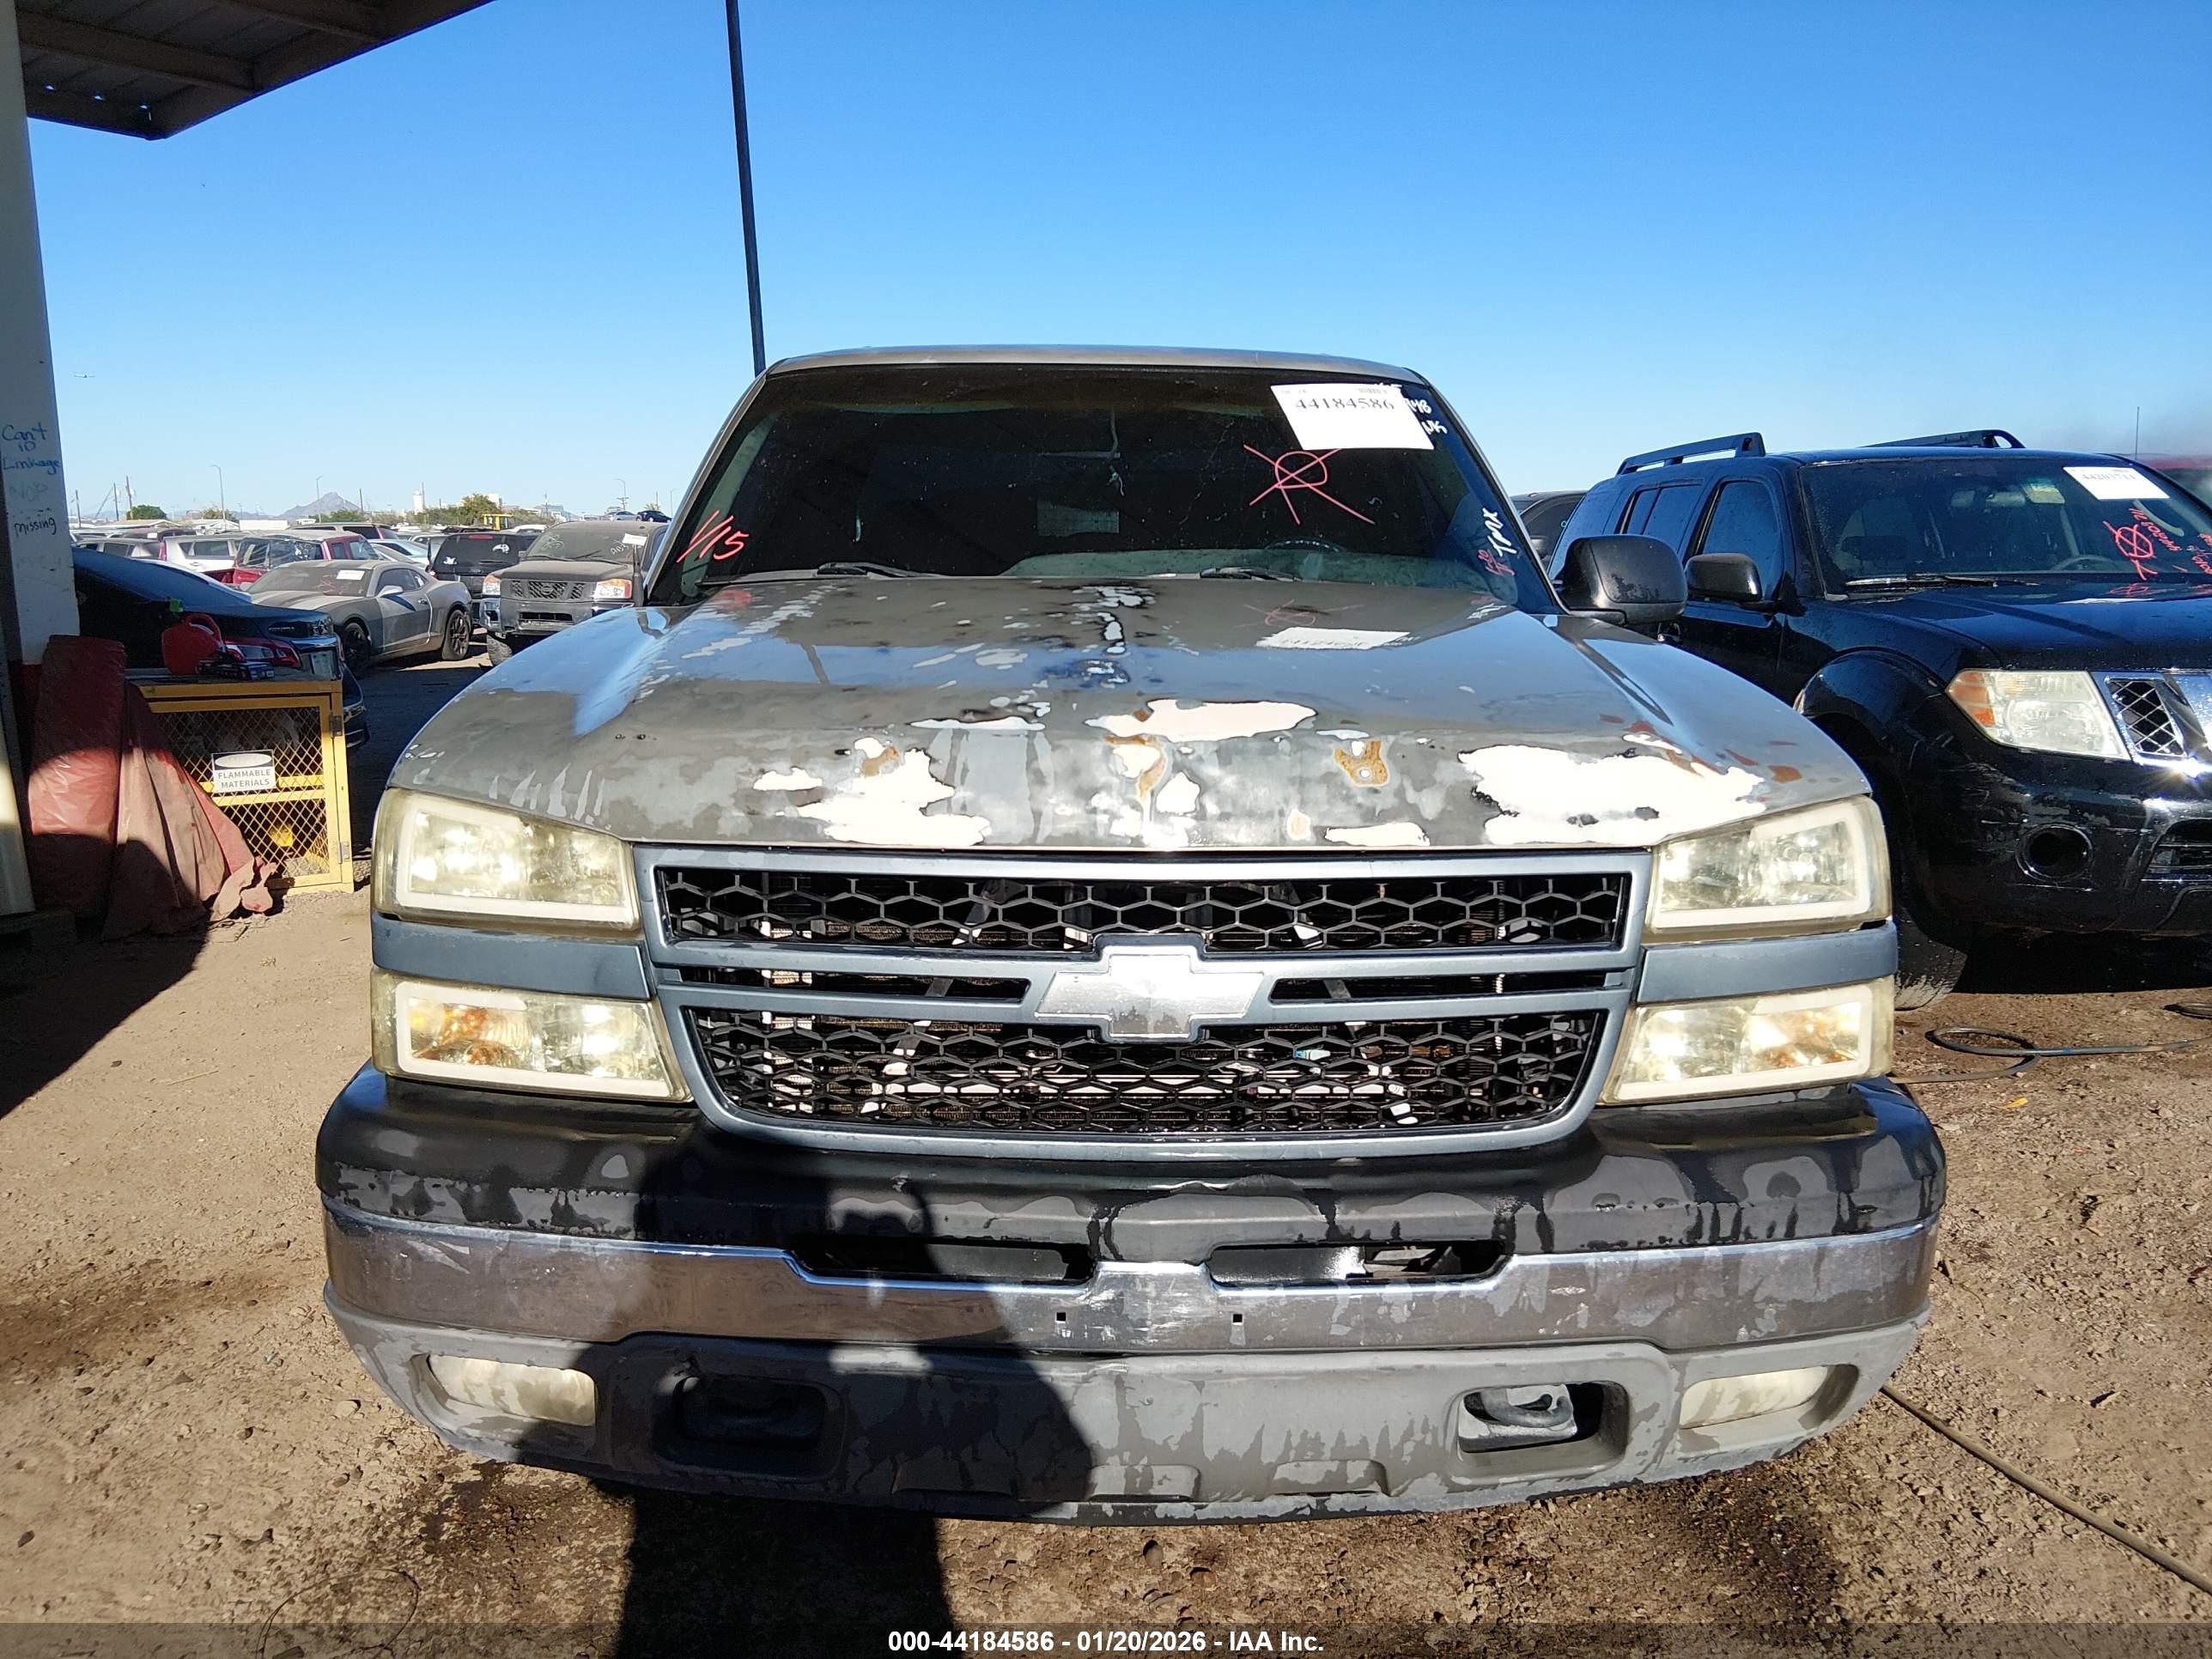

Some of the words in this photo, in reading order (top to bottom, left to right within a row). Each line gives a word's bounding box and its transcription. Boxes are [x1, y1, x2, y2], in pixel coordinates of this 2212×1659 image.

[1296, 398, 1395, 410] 44184586
[218, 769, 270, 779] FLAMMABLE
[221, 779, 270, 788] MATERIALS
